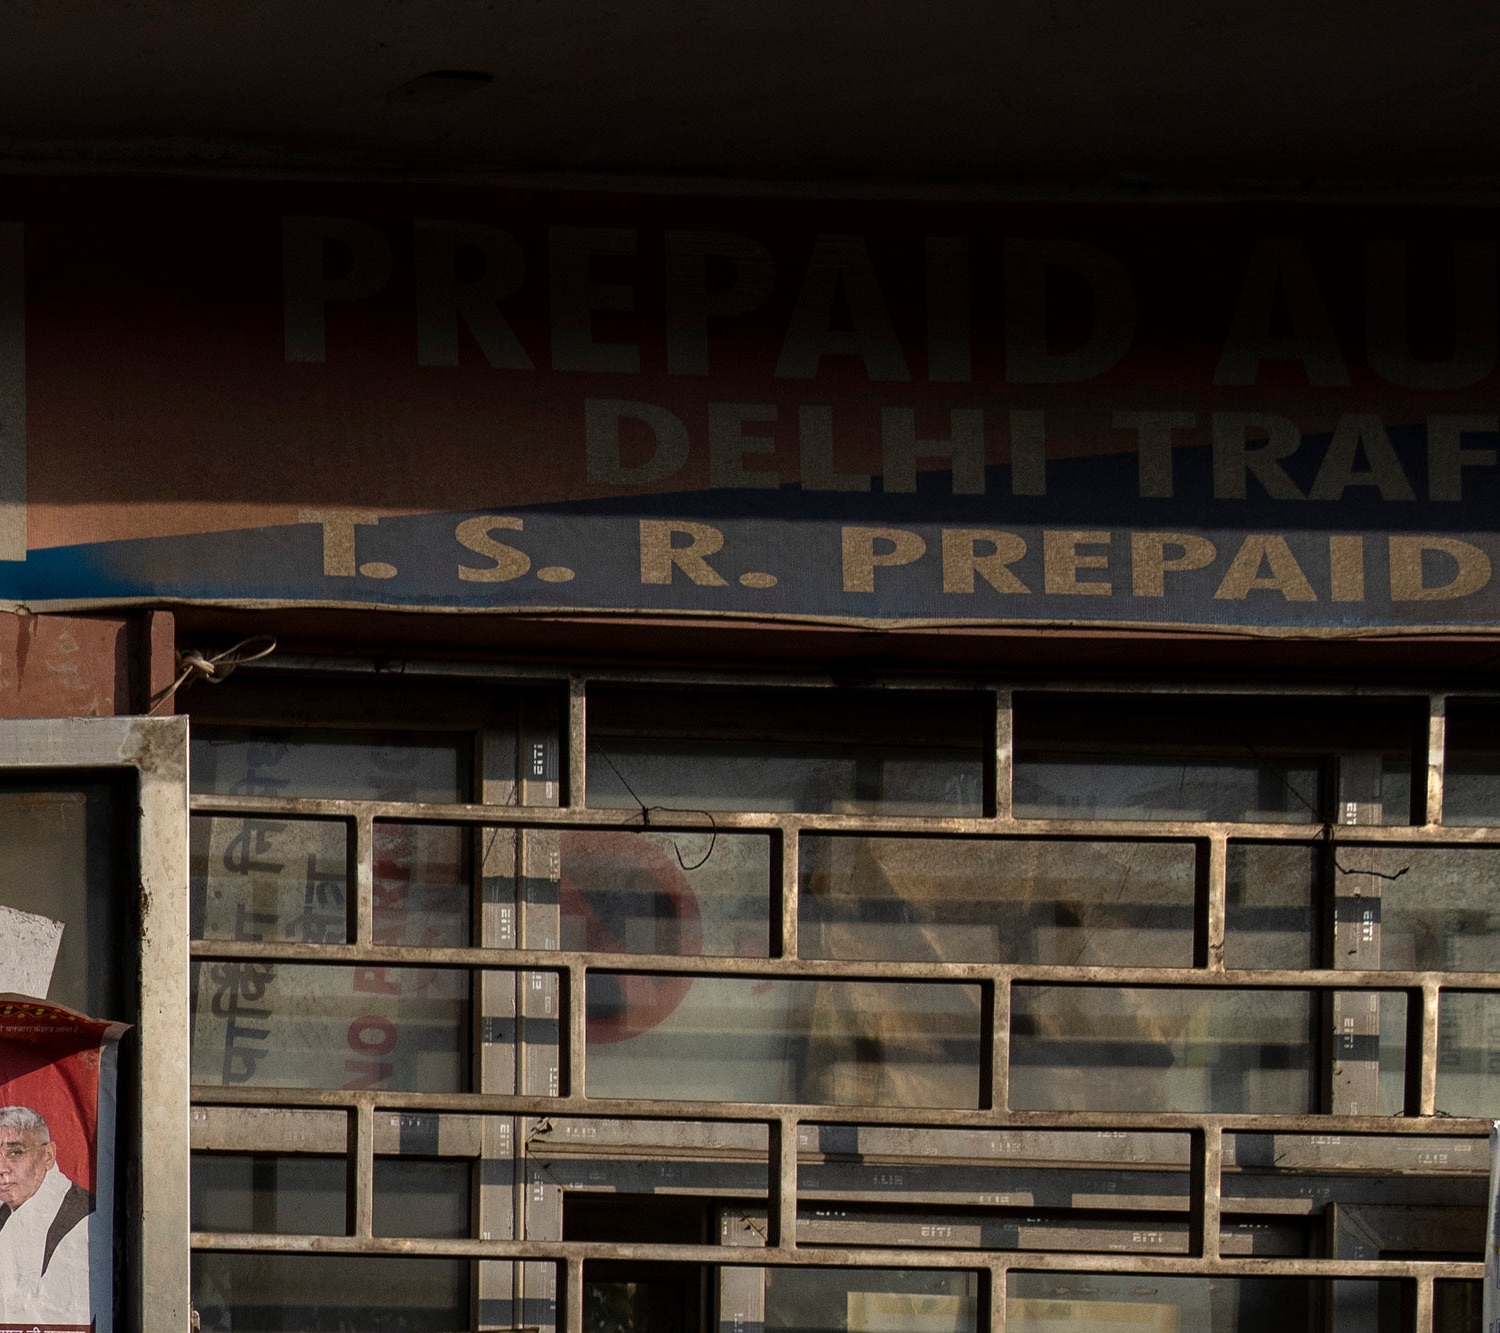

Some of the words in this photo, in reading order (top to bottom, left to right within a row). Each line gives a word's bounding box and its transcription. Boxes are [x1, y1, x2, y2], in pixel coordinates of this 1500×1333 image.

[281, 213, 1139, 384] PREPAID
[584, 398, 1047, 495] DELHI
[299, 508, 398, 581] T.
[455, 515, 576, 584] S.
[639, 519, 778, 589] R.
[841, 525, 1492, 602] PREPAID
